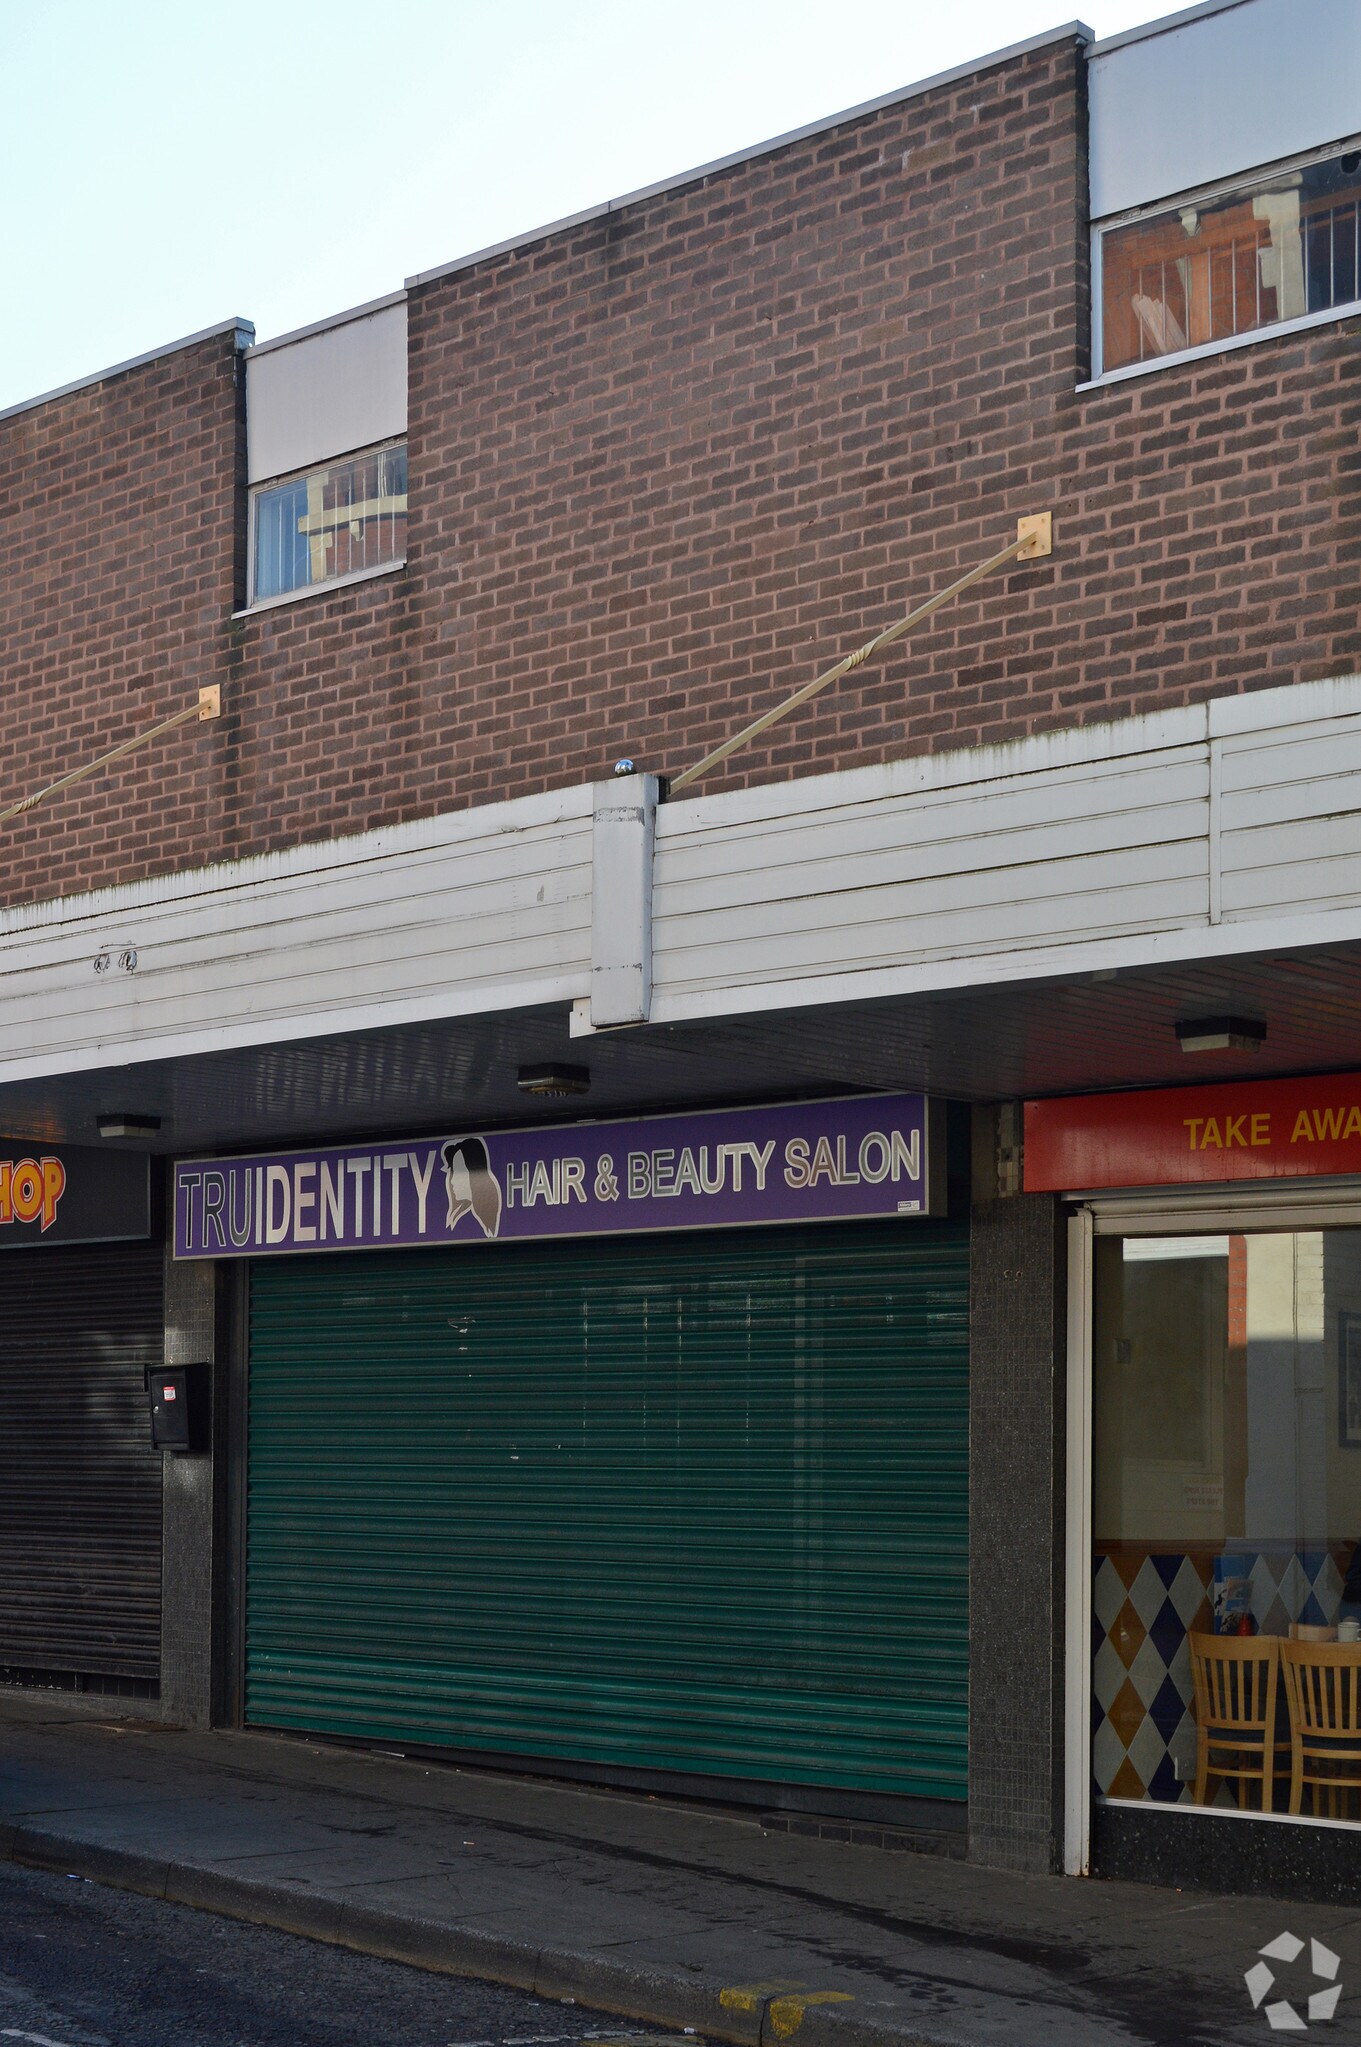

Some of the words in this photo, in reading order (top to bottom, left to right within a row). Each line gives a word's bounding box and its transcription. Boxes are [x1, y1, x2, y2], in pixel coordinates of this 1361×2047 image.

[1183, 1113, 1271, 1150] TAKE
[507, 1157, 587, 1208] HAIR
[594, 1153, 620, 1202] &
[628, 1140, 776, 1199] BEAUTY
[784, 1129, 920, 1189] SALON
